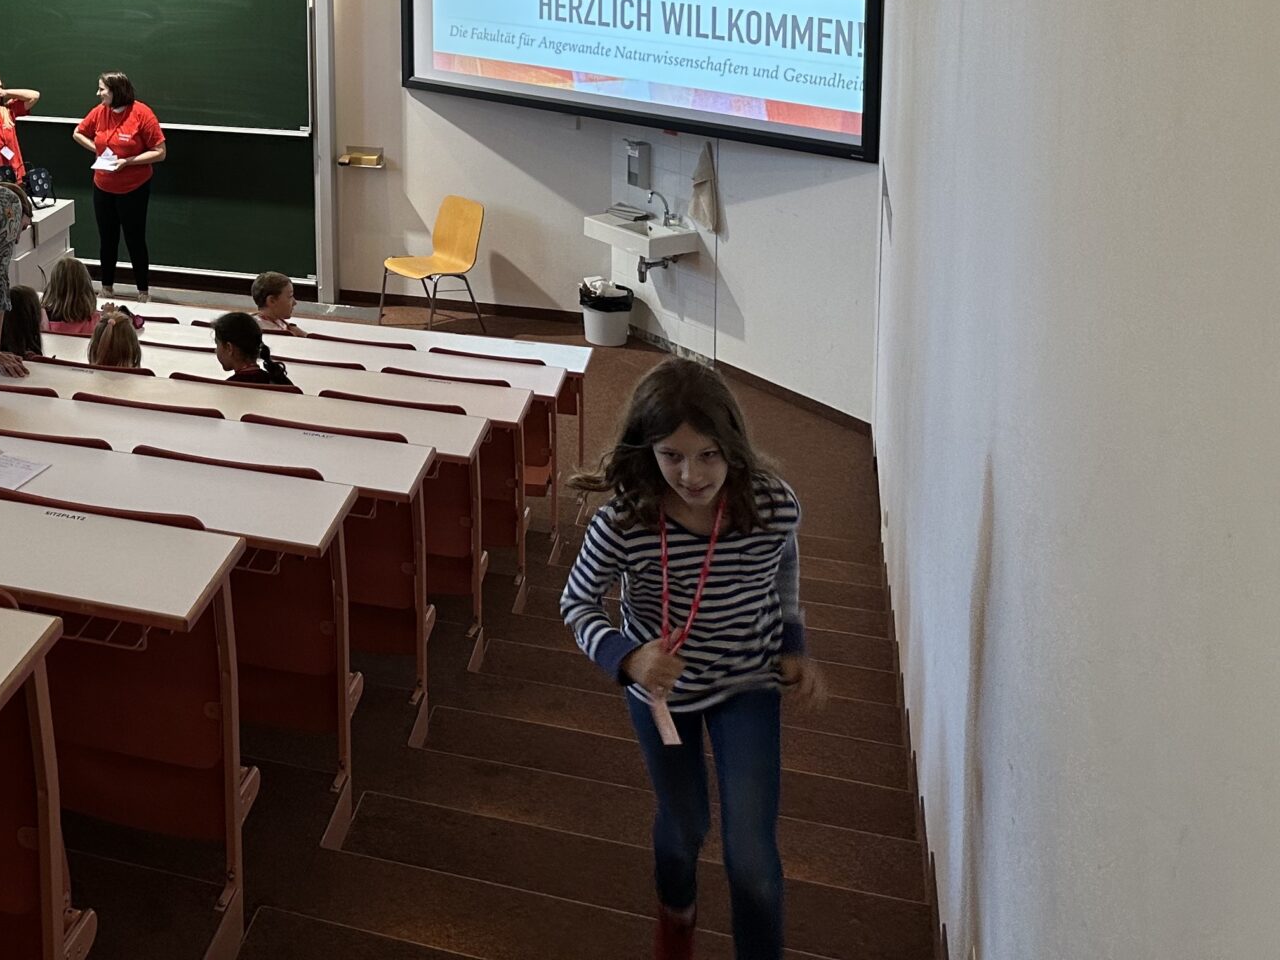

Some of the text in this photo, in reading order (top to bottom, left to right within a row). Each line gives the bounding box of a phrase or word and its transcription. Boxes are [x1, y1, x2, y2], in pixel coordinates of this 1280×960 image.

[449, 24, 469, 38] Die
[470, 26, 516, 45] Fakultät
[517, 34, 536, 50] für
[538, 36, 612, 59] Angewandte
[613, 44, 749, 78] Naturwissenschaften
[753, 64, 781, 81] und
[661, 0, 864, 58] WILLKOMMEN!
[45, 510, 87, 521] SITZPLATZ
